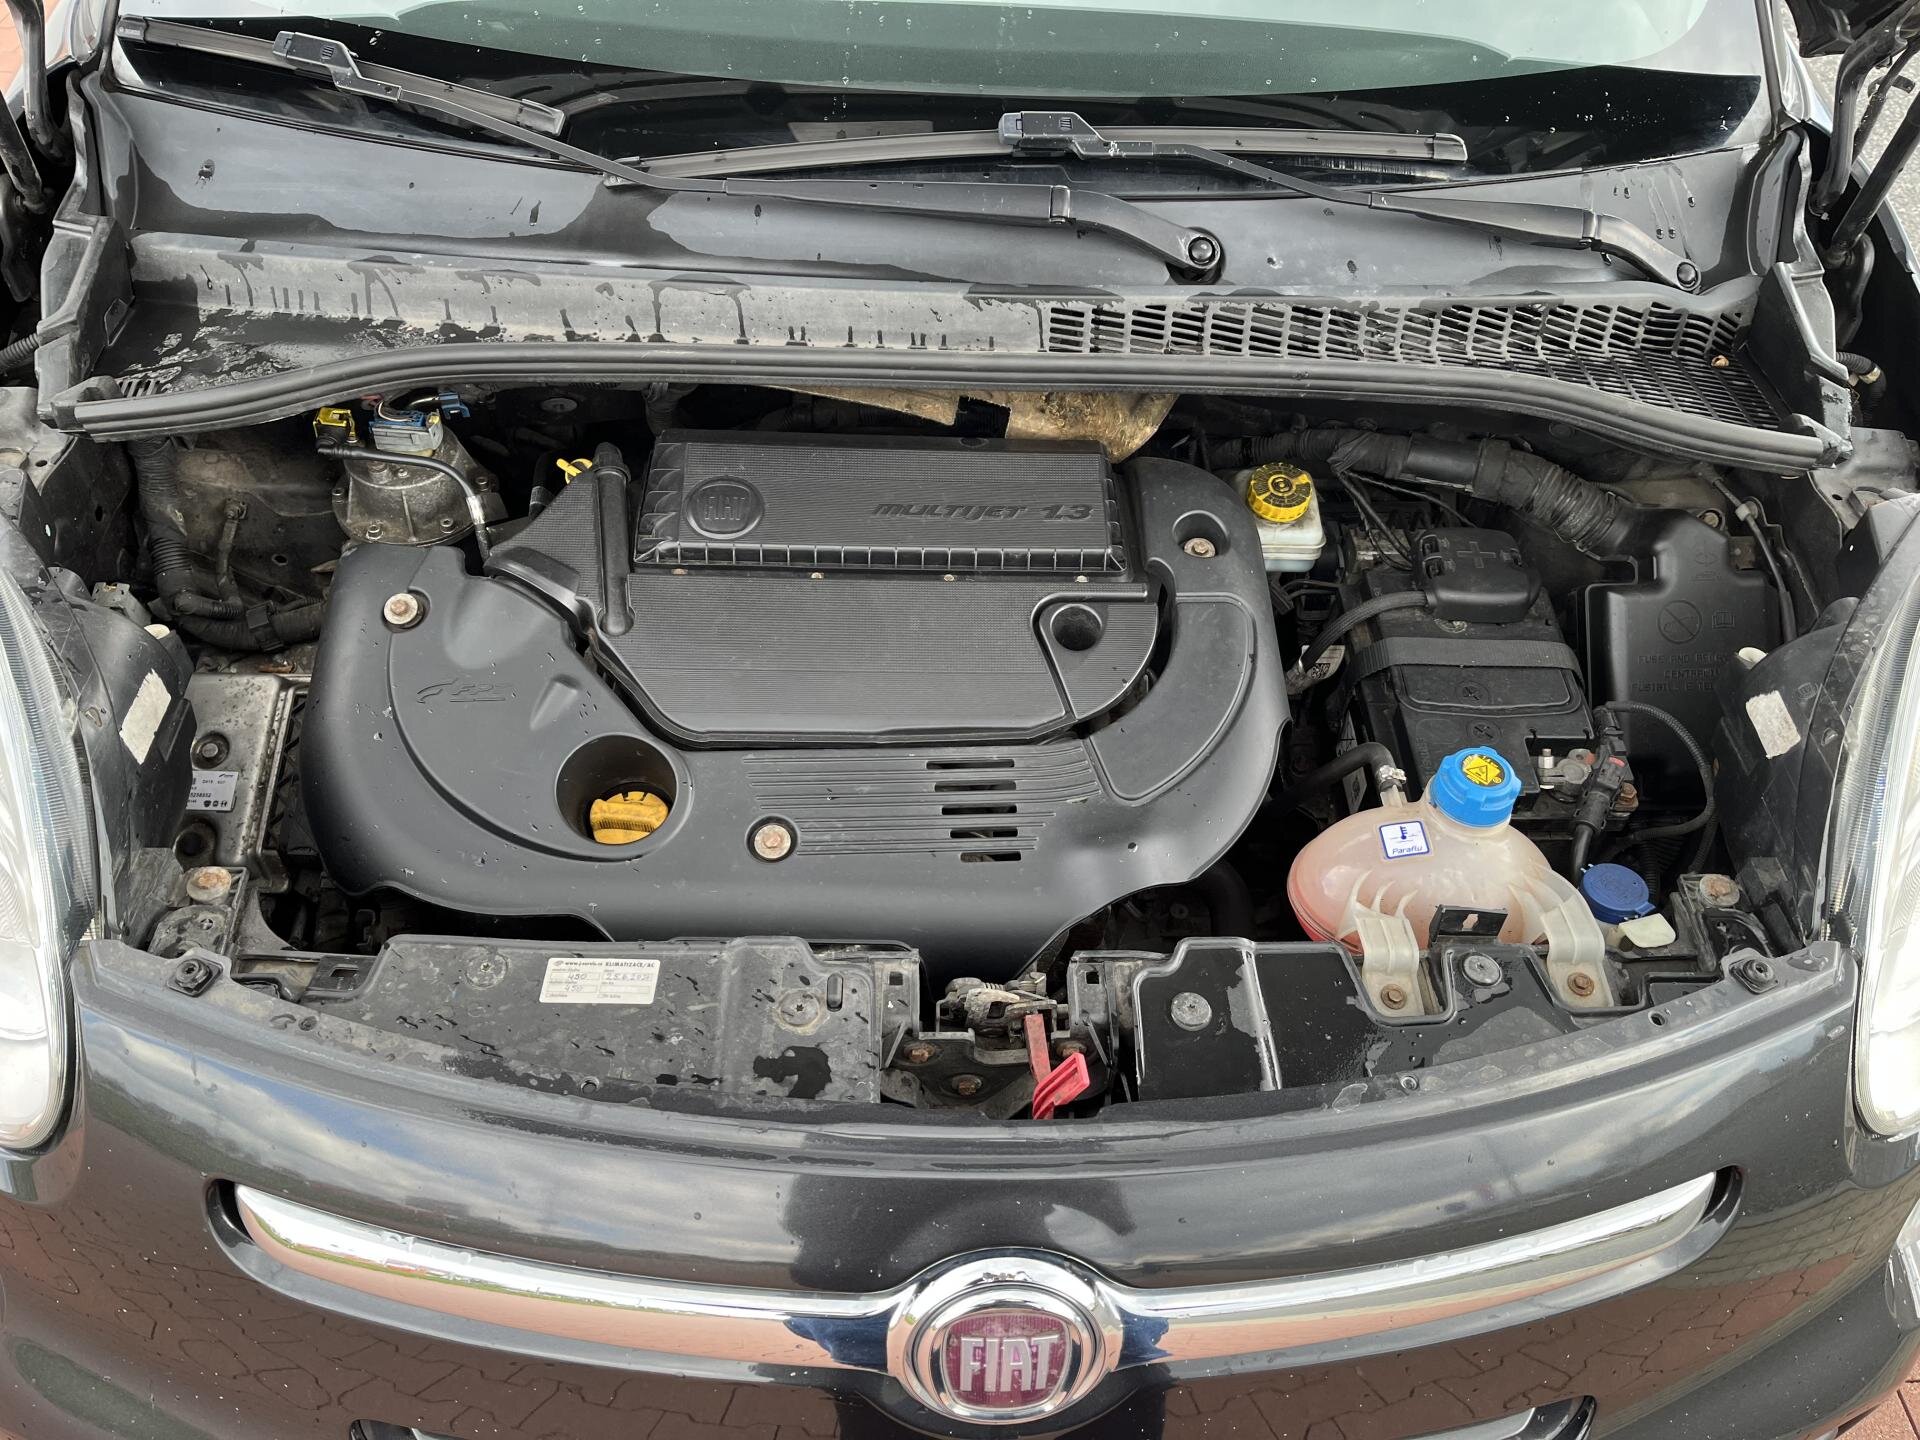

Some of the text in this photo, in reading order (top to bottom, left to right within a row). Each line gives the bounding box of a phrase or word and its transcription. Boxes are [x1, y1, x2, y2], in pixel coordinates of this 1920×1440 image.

[703, 495, 746, 520] FIAT
[872, 503, 1029, 522] MULTIJET
[1392, 845, 1423, 855] Paraflu
[960, 1333, 1060, 1393] FIAT
